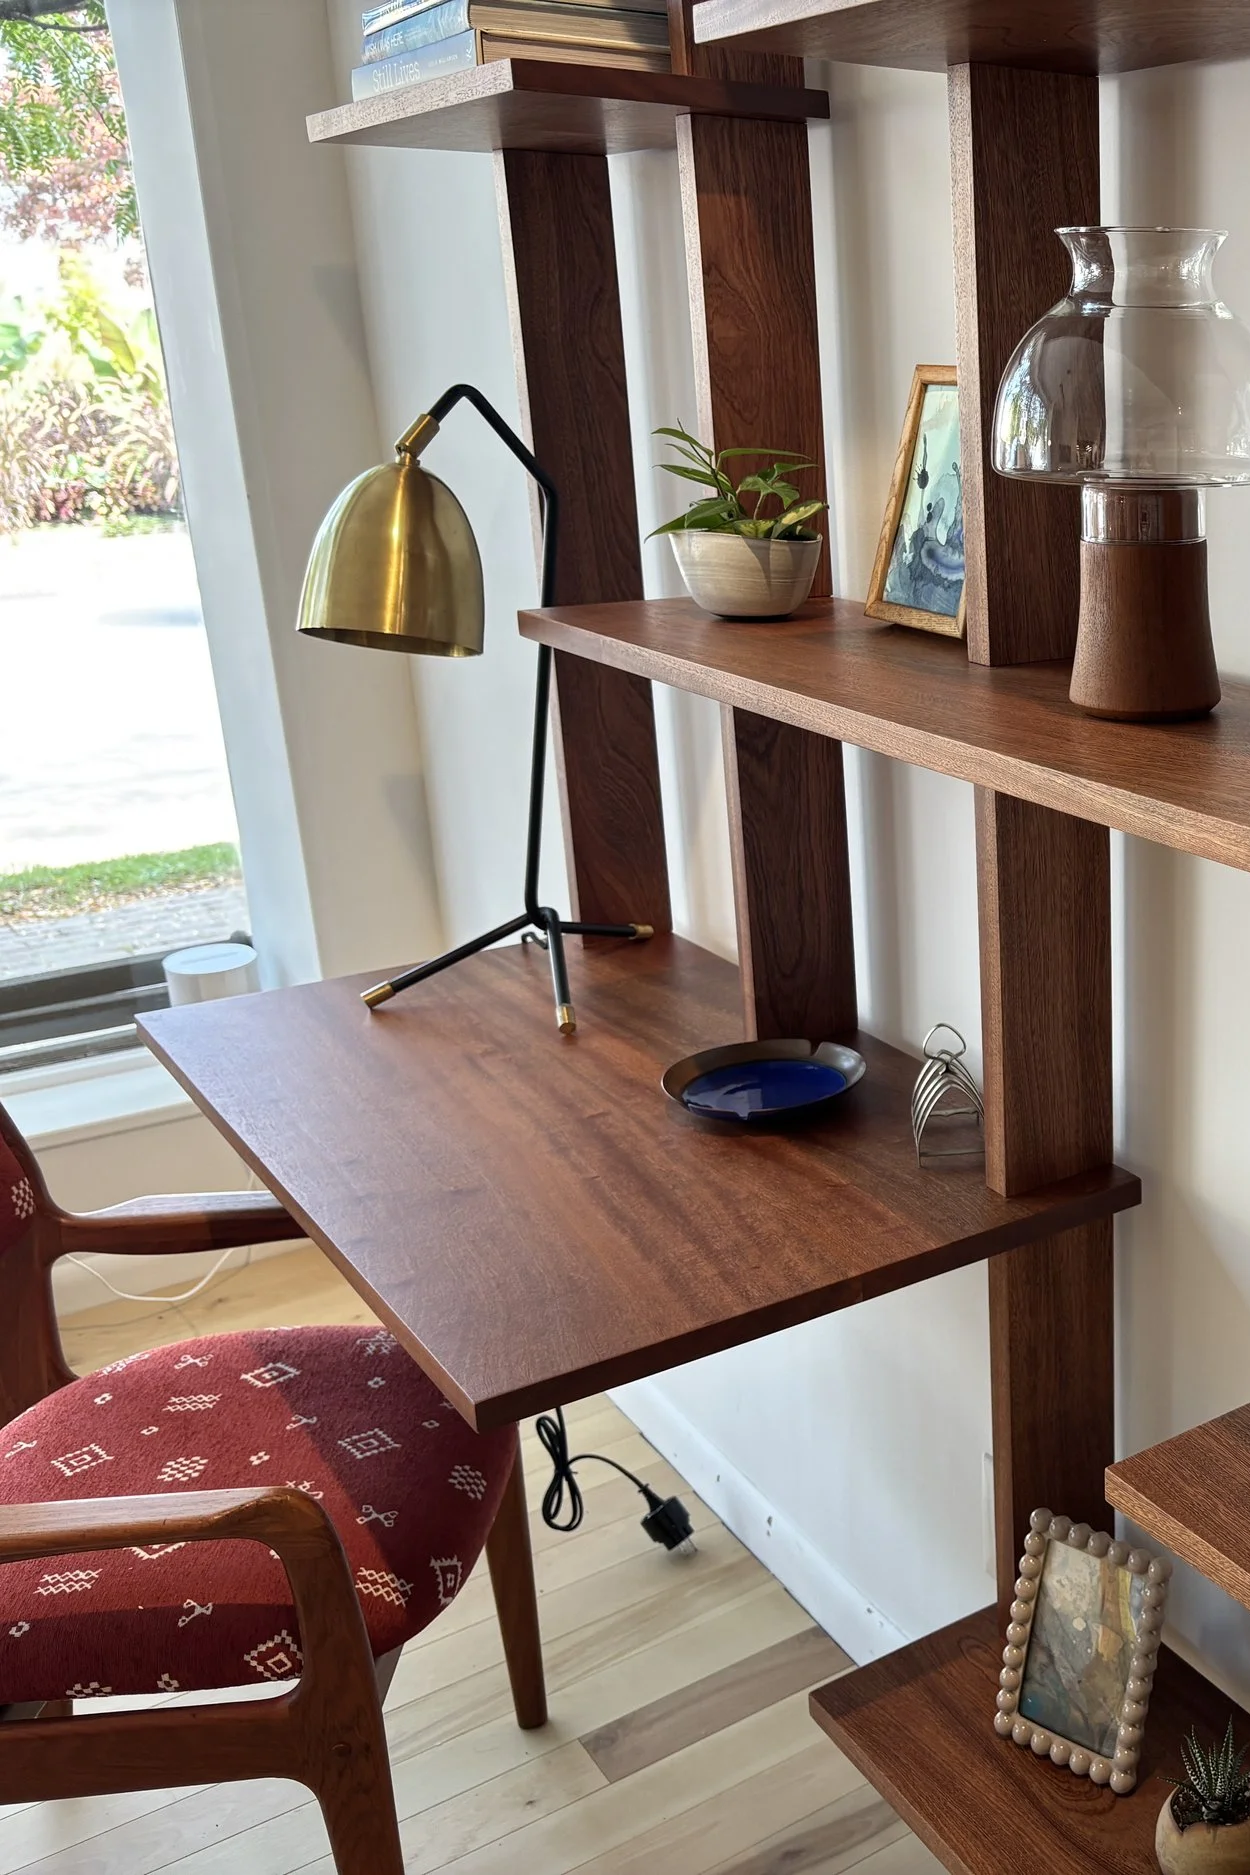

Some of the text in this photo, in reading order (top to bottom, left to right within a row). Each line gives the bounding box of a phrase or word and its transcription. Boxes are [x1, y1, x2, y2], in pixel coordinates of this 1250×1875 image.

[391, 31, 404, 46] HERE
[371, 62, 393, 92] Still
[394, 60, 421, 85] Lives
